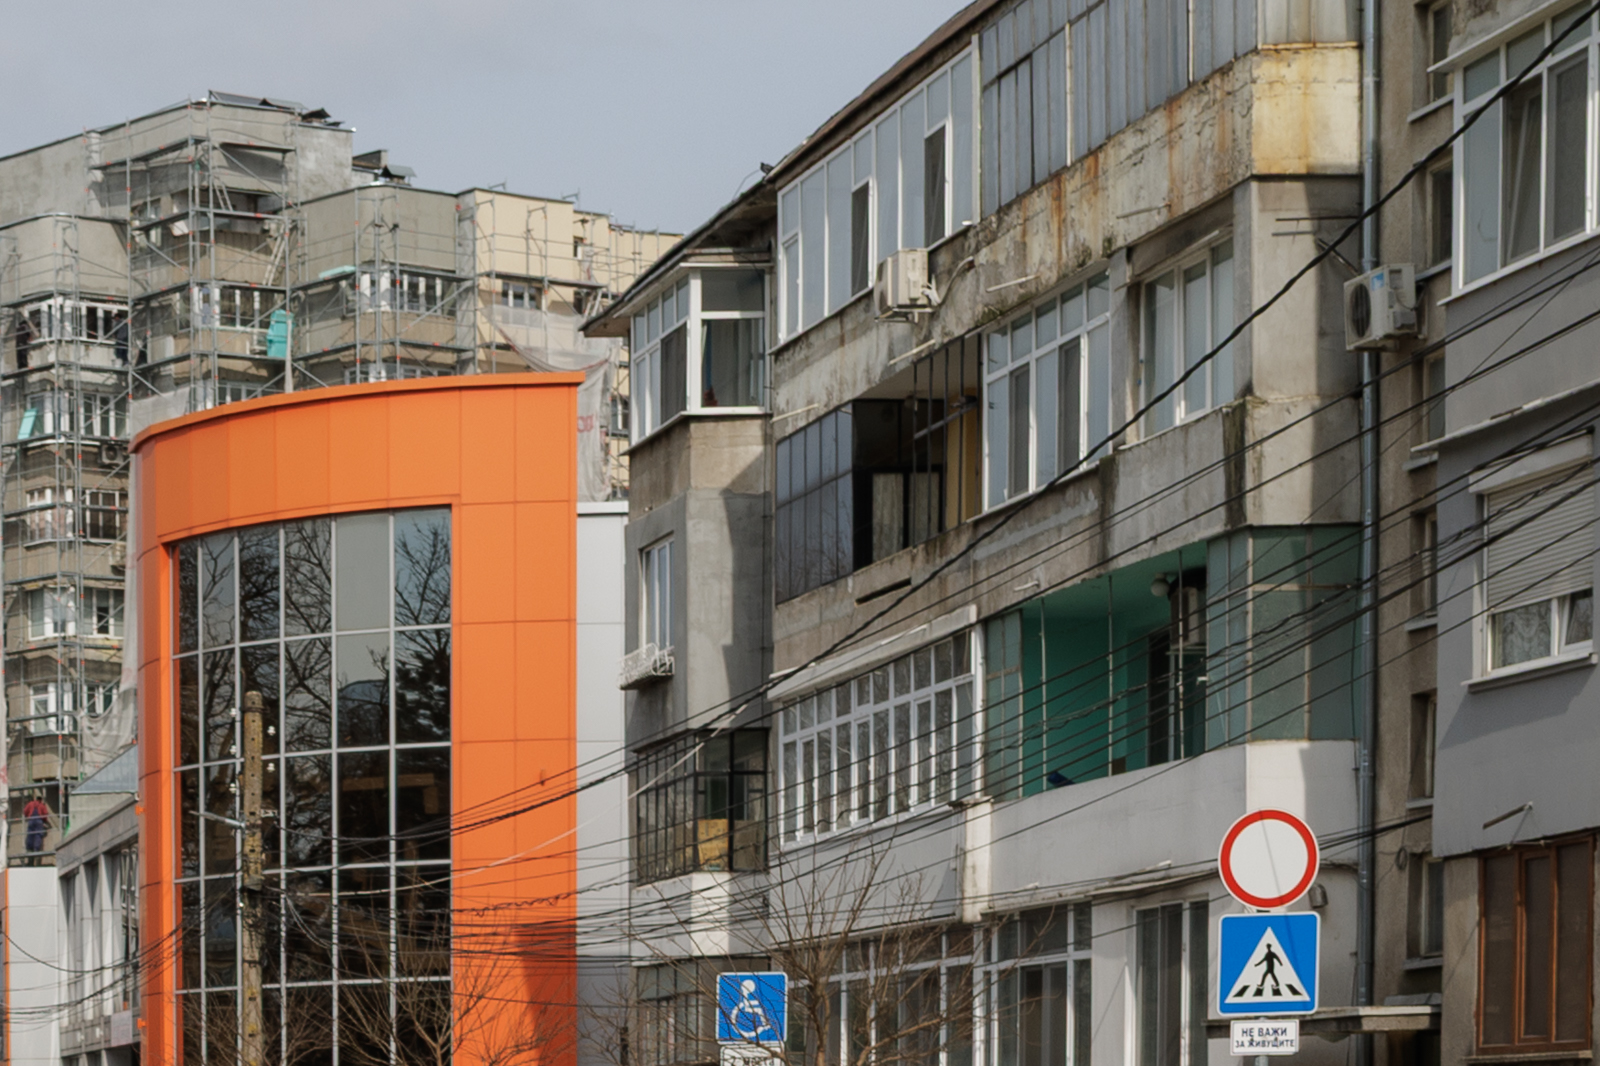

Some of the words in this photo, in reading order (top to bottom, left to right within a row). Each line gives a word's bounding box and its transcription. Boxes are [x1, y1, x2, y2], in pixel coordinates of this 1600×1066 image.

[1242, 1028, 1255, 1037] НЕ
[1258, 1027, 1287, 1037] ВАЖИ
[1235, 1040, 1245, 1048] ЗА
[1247, 1039, 1295, 1049] ЖИВУЩИТЕ
